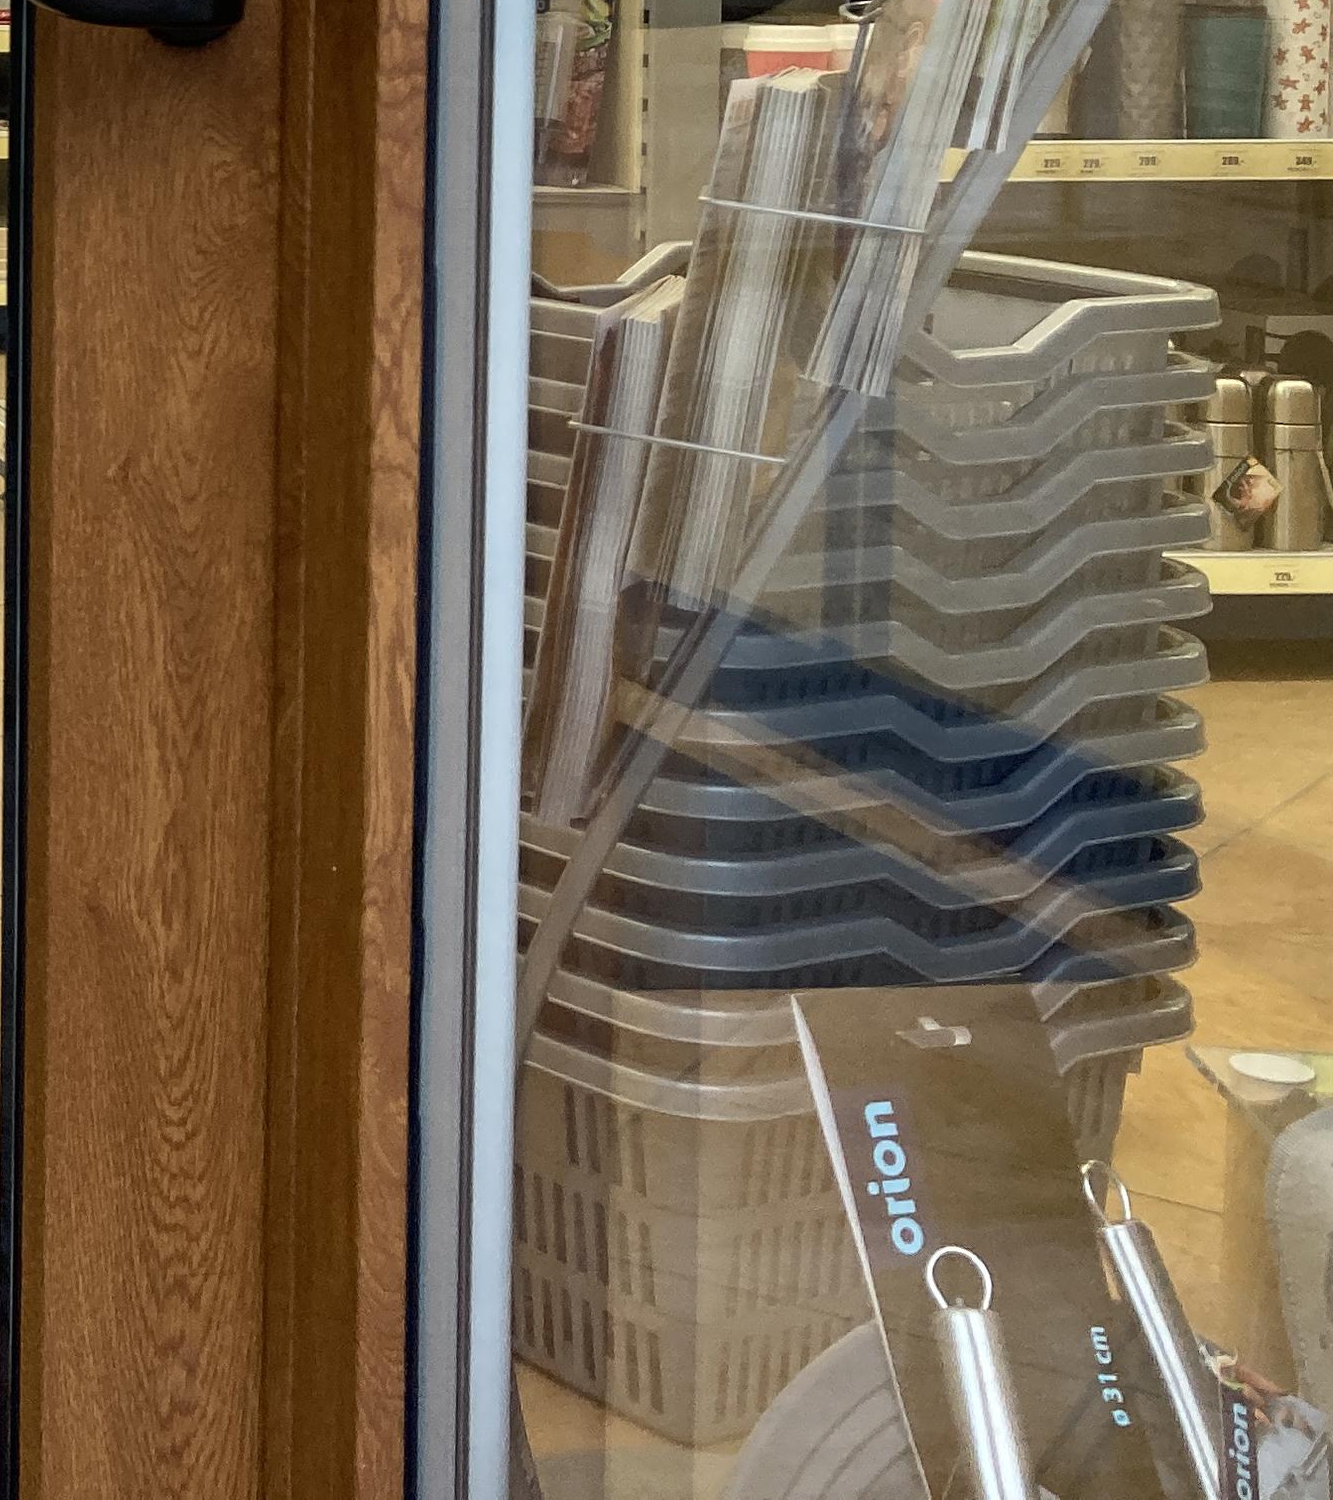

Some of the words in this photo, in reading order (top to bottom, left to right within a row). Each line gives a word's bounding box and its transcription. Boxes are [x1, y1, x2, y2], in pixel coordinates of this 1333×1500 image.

[864, 1101, 925, 1256] orion
[1090, 1326, 1113, 1365] cm
[1097, 1372, 1124, 1403] 31
[1229, 1402, 1253, 1500] orion
